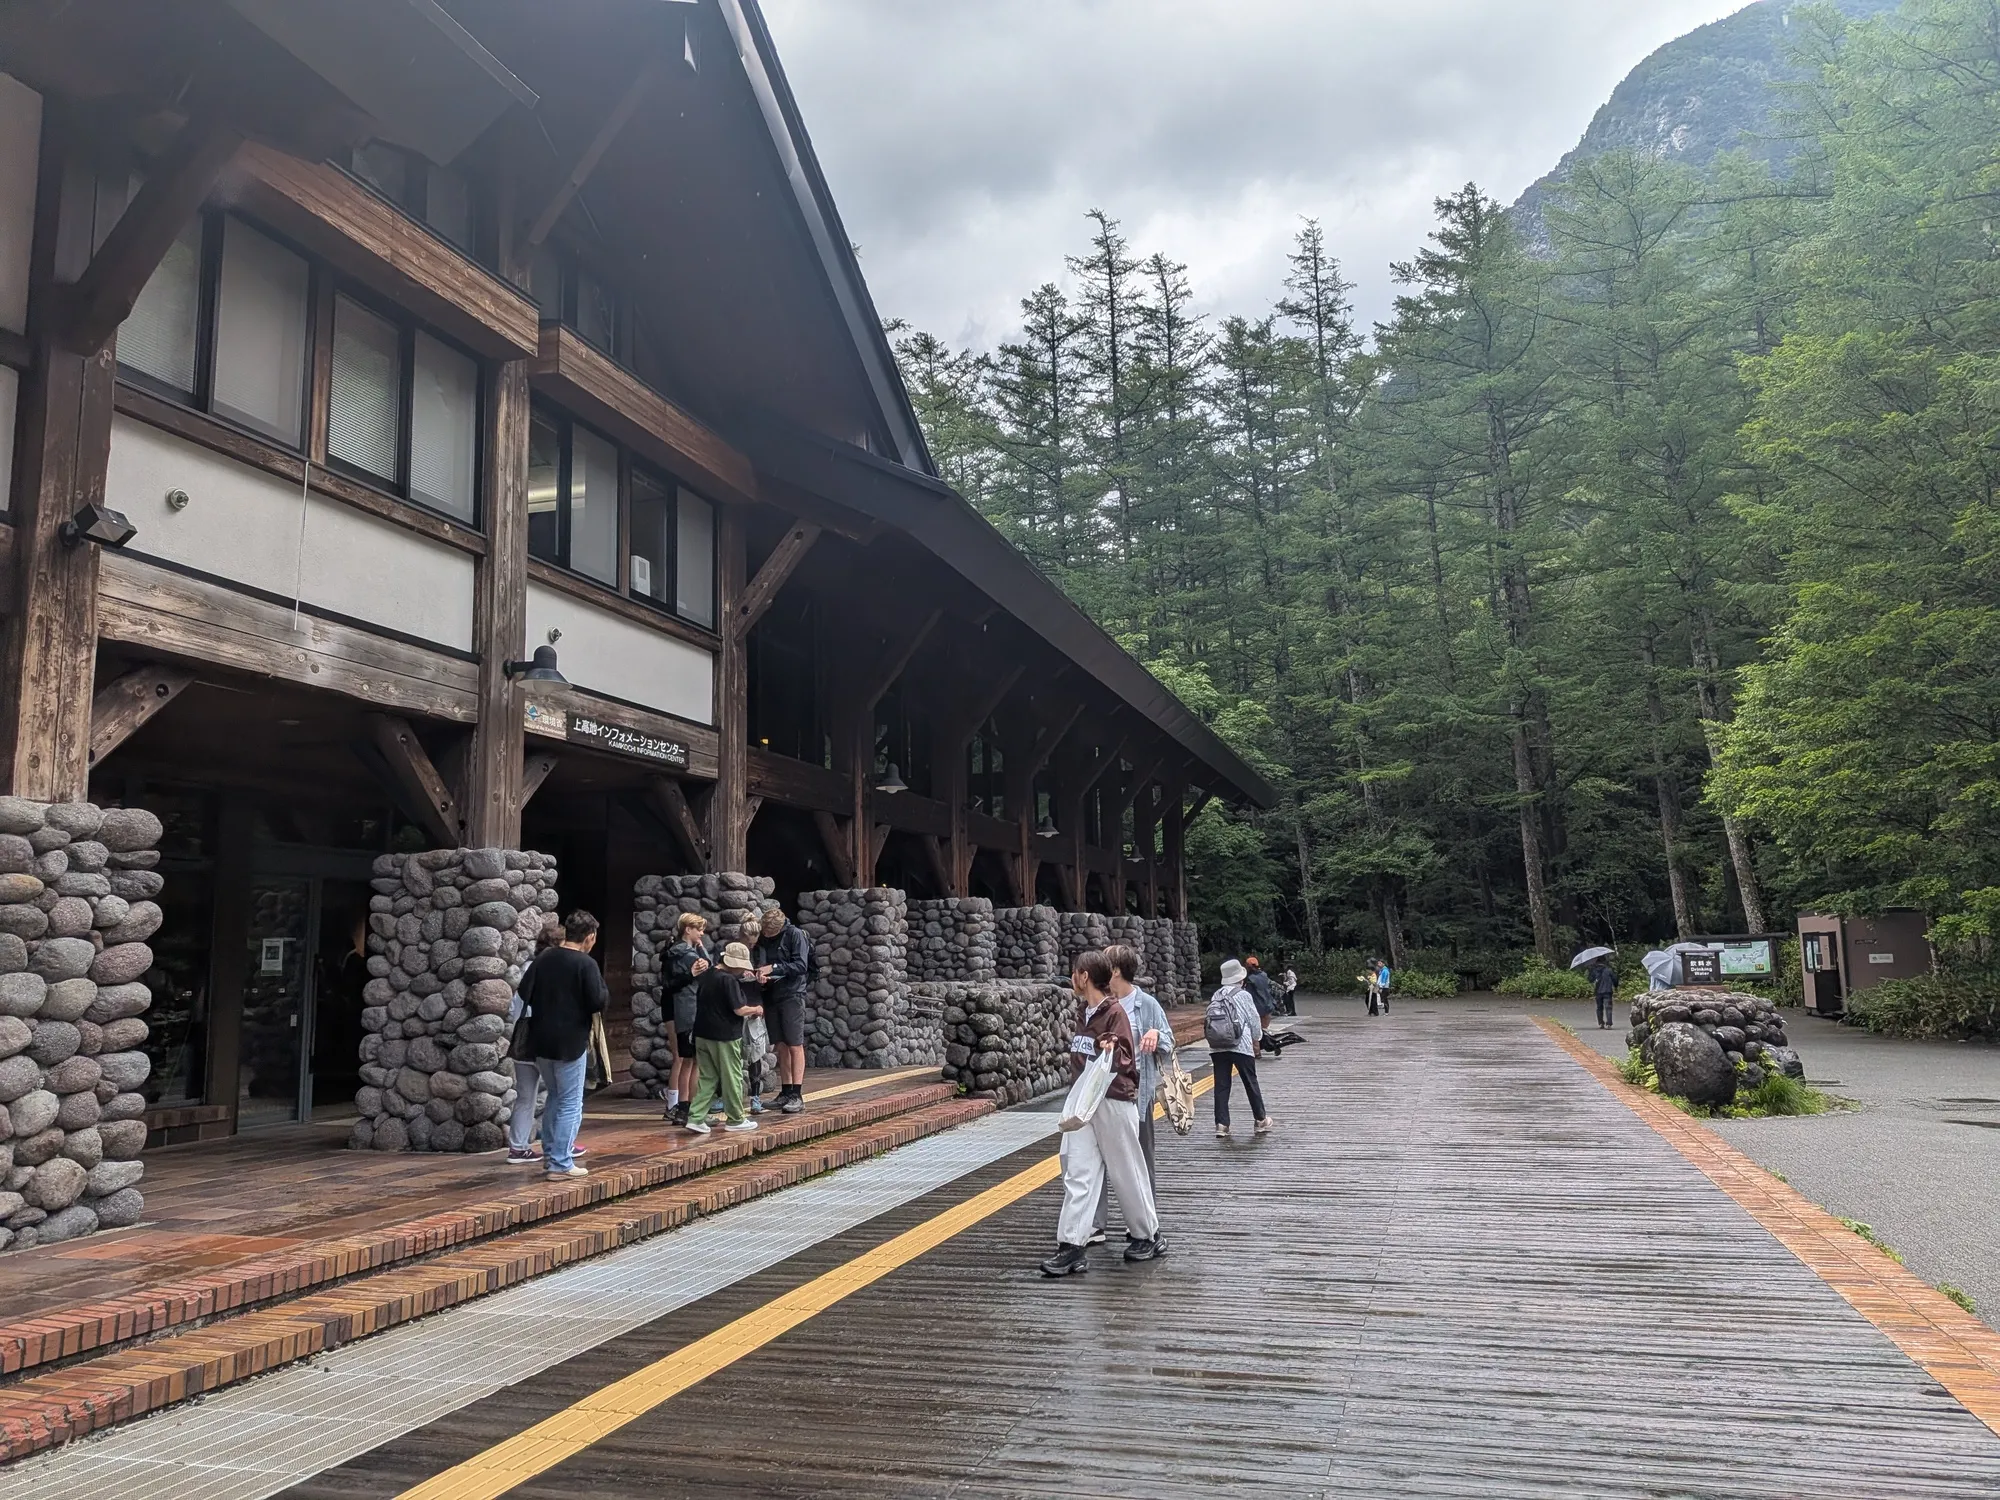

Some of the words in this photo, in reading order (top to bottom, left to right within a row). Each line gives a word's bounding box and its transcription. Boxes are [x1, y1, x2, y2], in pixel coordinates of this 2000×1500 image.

[573, 717, 685, 755] 上高地インフォメーションセンター
[608, 740, 636, 753] KAMIKOCHI
[636, 746, 668, 760] INFORMATION
[667, 753, 685, 764] CENTER
